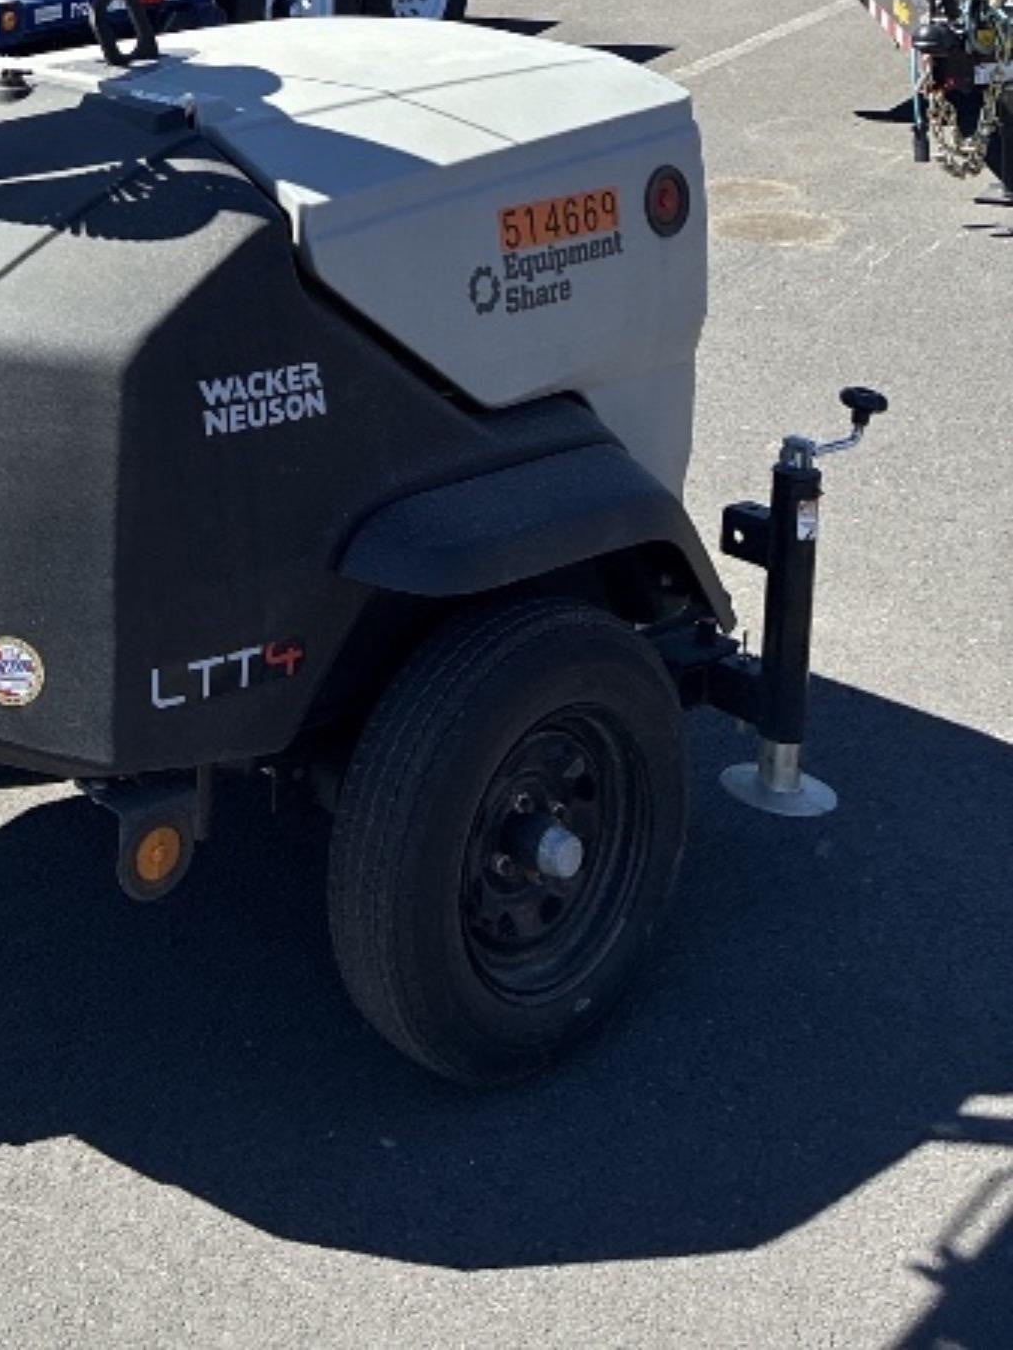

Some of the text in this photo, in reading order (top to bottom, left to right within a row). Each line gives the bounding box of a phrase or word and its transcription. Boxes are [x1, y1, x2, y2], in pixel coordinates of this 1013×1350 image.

[502, 191, 615, 249] 514669
[503, 231, 625, 282] Equipment
[505, 279, 572, 314] Share
[197, 361, 323, 406] WACKER
[202, 389, 327, 437] NEUSON
[151, 641, 303, 709] LTT4
